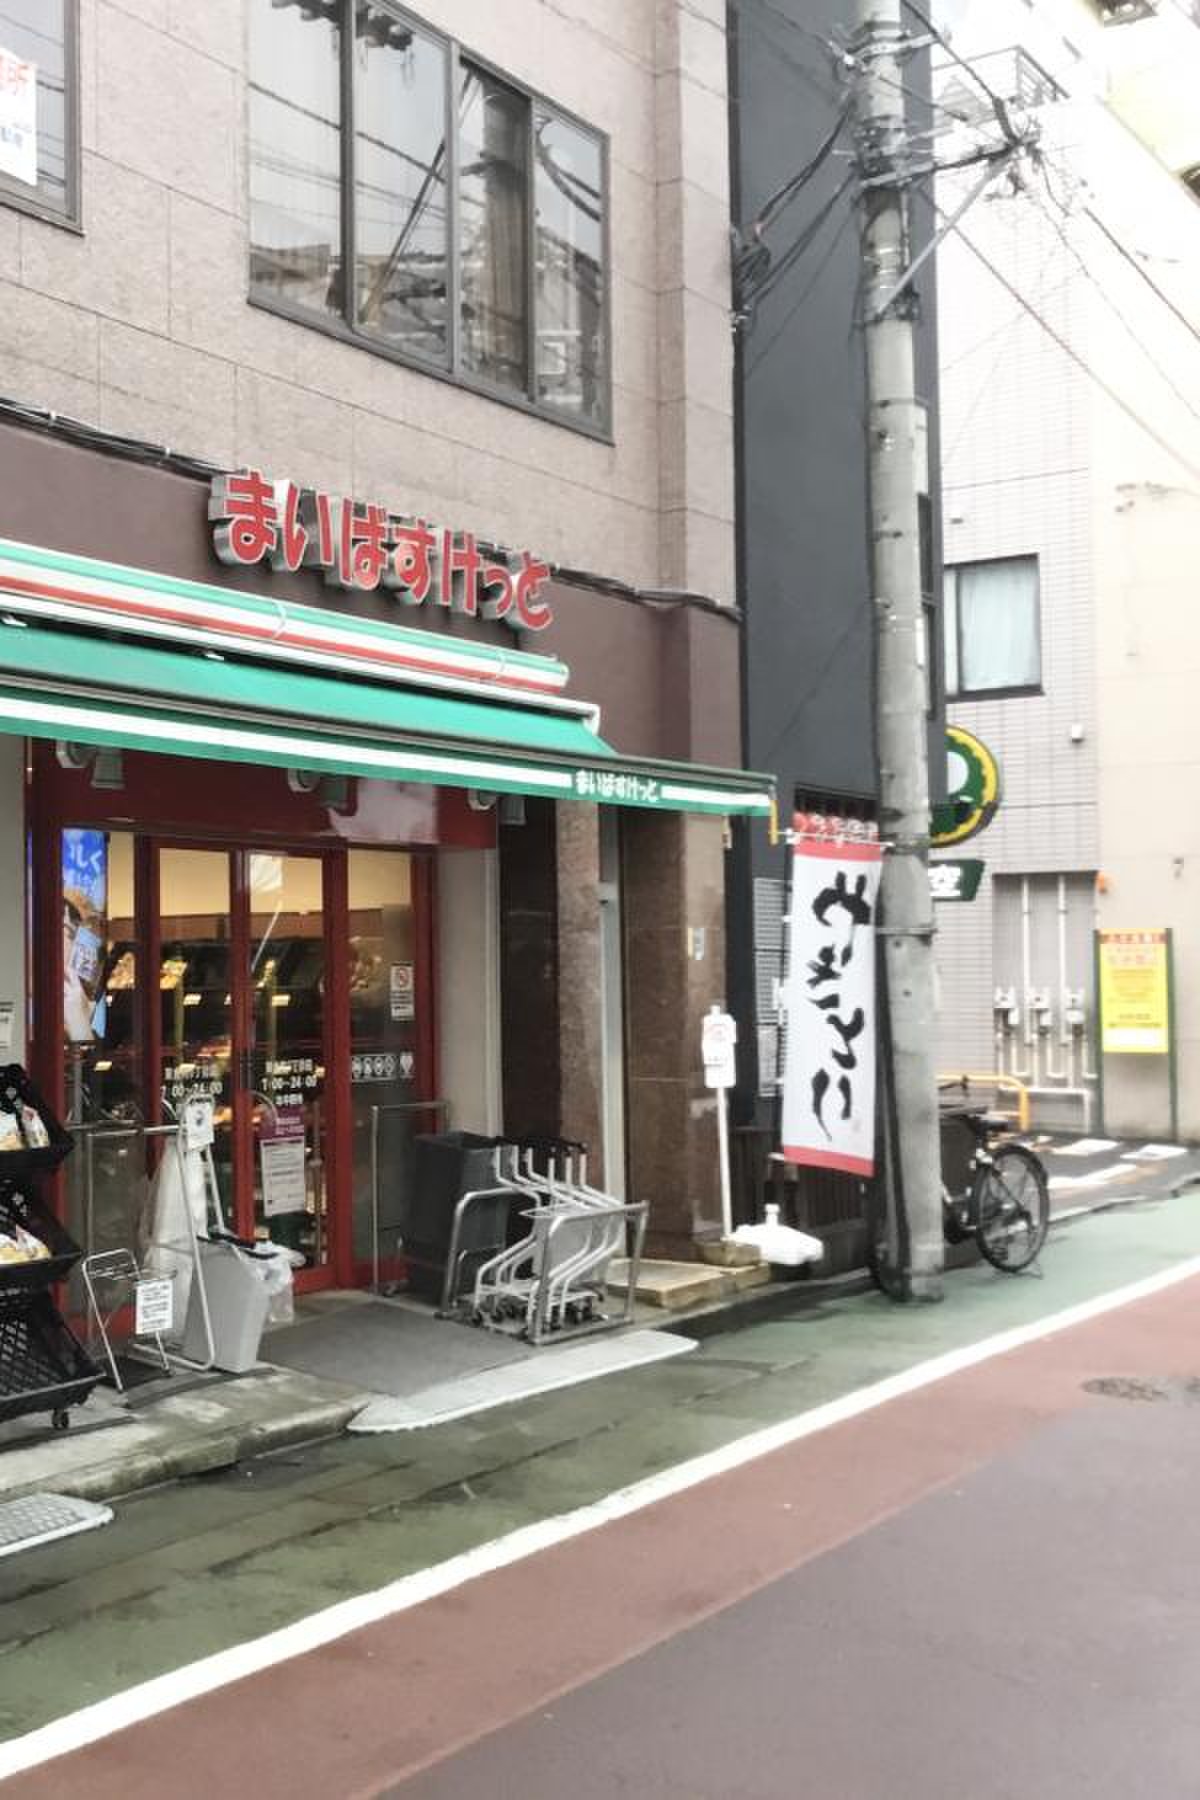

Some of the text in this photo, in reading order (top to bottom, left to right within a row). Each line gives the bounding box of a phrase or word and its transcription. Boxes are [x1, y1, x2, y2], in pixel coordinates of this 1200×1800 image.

[222, 467, 553, 631] まいばすけっと
[576, 769, 660, 803] まいばすけっと
